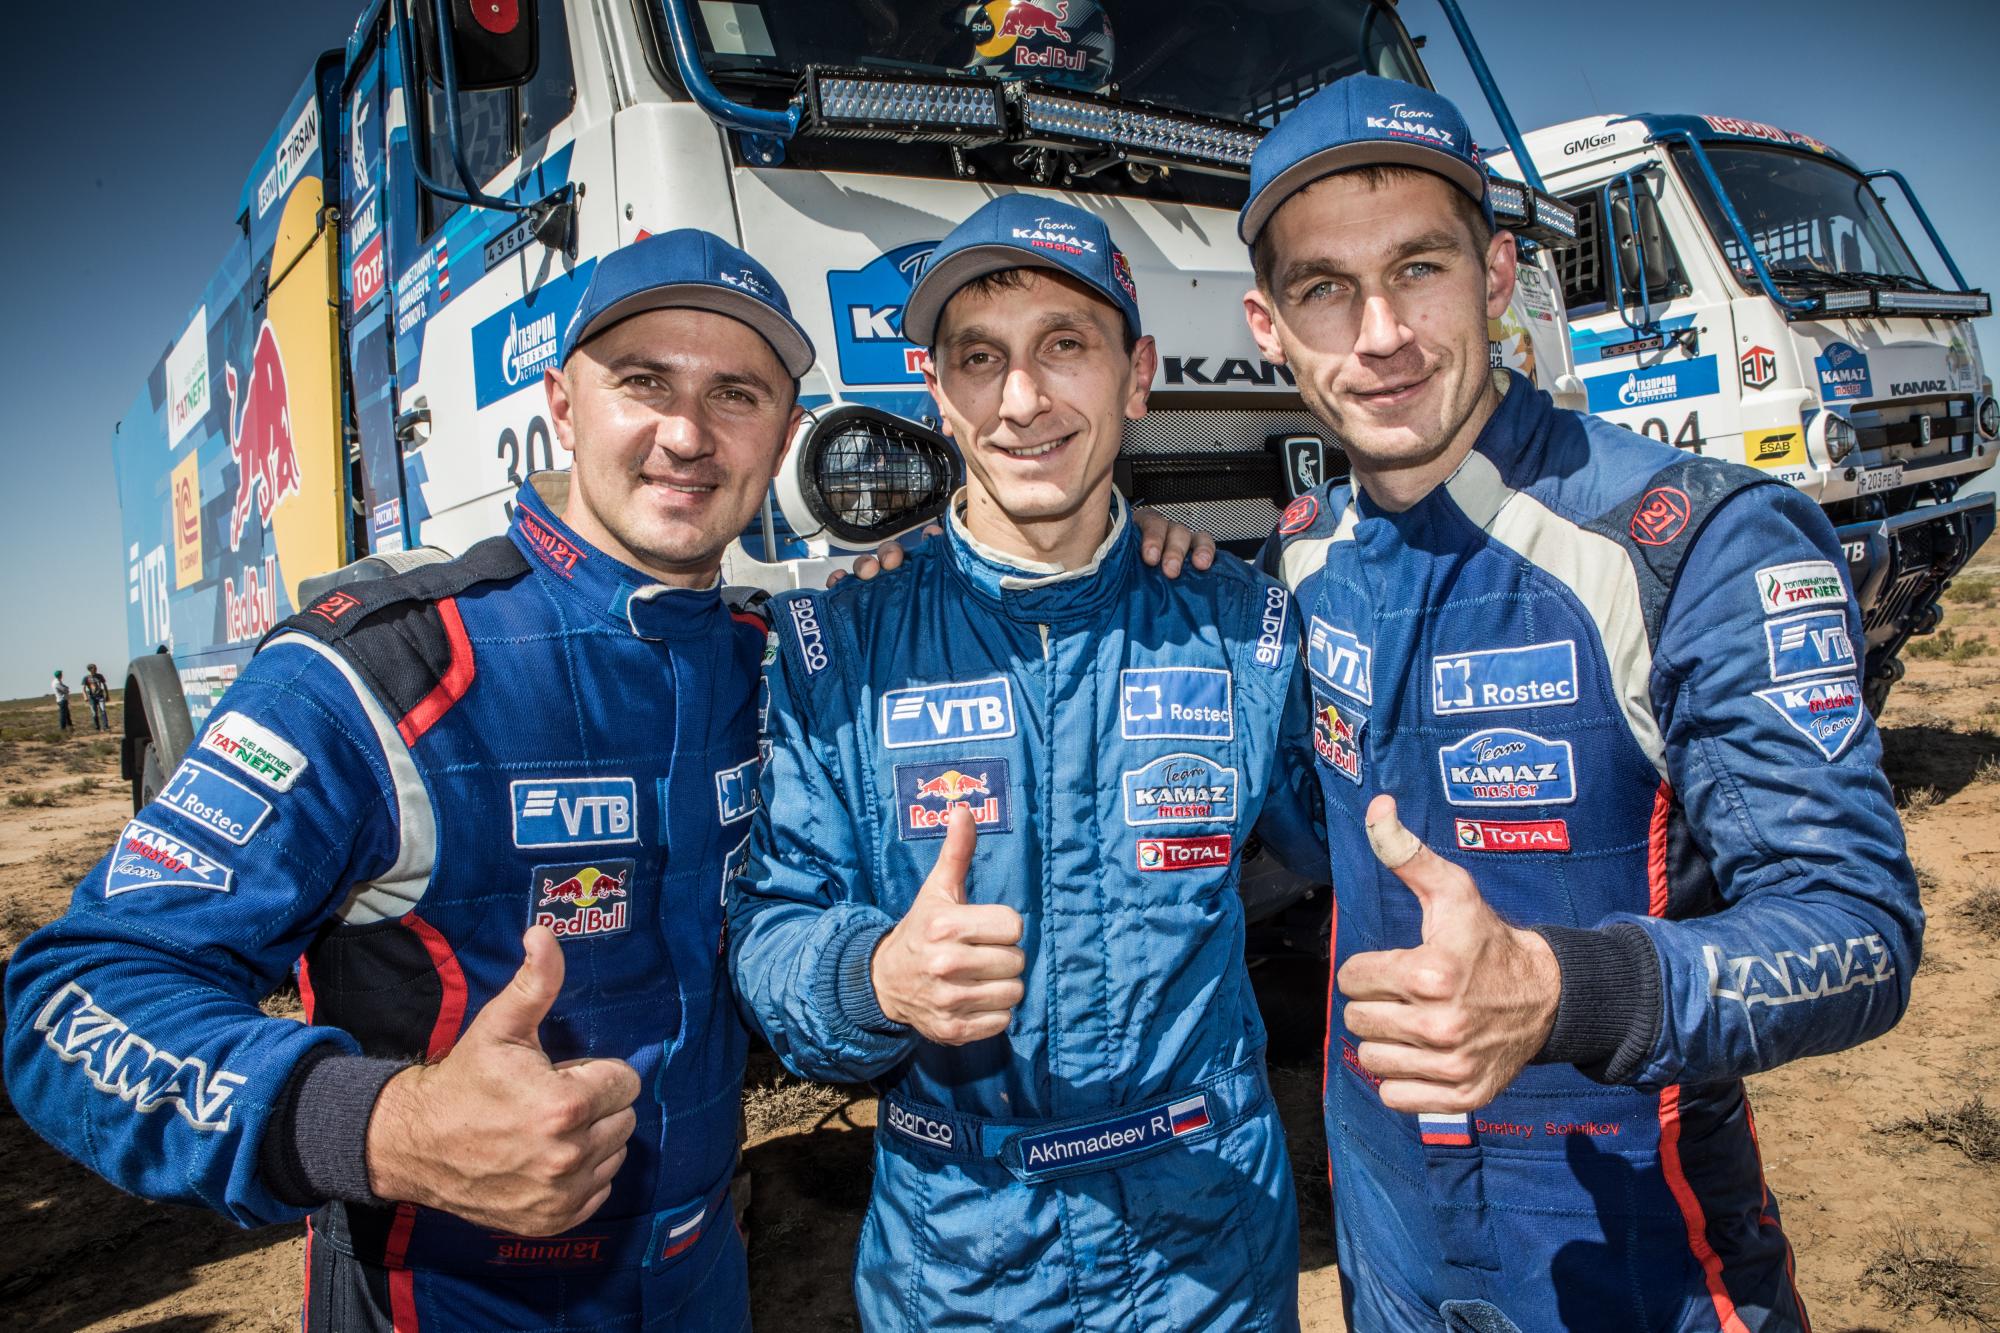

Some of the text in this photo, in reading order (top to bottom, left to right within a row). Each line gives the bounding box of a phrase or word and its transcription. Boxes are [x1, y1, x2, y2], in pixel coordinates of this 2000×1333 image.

[972, 22, 992, 32] Stilo
[1015, 45, 1087, 71] Red Bull
[1389, 103, 1434, 118] Team
[1366, 116, 1455, 147] KAMAZ
[1563, 133, 1616, 156] GMGen
[1034, 217, 1077, 230] Team
[1012, 228, 1097, 253] KAMAZ
[518, 311, 557, 354] ГАЗПРОМ
[520, 354, 558, 382] АСТРАХАНЬ
[1821, 368, 1867, 384] KAMAZ
[1637, 374, 1676, 391] ГАЗПРОМ
[1890, 381, 1947, 397] KAMAZ
[1760, 441, 1791, 454] ESAB
[1641, 501, 1676, 533] 21
[139, 544, 171, 648] VTB
[224, 553, 277, 645] Red Bull
[1785, 585, 1842, 602] TATNEFT
[316, 596, 354, 618] 21
[1255, 587, 1284, 663] sparco
[1483, 680, 1571, 705] Rostec
[926, 696, 1006, 735] VTB
[1170, 703, 1230, 723] Rostec
[1811, 714, 1855, 739] Team
[212, 733, 287, 783] TATNEFT
[239, 736, 294, 774] FUEL PARTNER
[1314, 729, 1358, 777] Red Bull
[1472, 737, 1526, 764] Team
[1162, 763, 1206, 784] Team
[1451, 763, 1560, 784] KAMAZ
[1135, 786, 1228, 806] KAMAZ
[1473, 783, 1539, 799] master
[181, 792, 243, 836] Rostec
[558, 795, 630, 836] VTB
[1158, 803, 1212, 818] master
[1484, 827, 1563, 844] TOTAL
[125, 825, 218, 880] KAMAZ
[125, 838, 189, 874] master
[1167, 844, 1226, 862] TOTAL
[113, 853, 162, 880] Team
[585, 901, 627, 932] Bull
[889, 1101, 953, 1143] sparco
[1028, 1116, 1171, 1166] Akhmadeev R.
